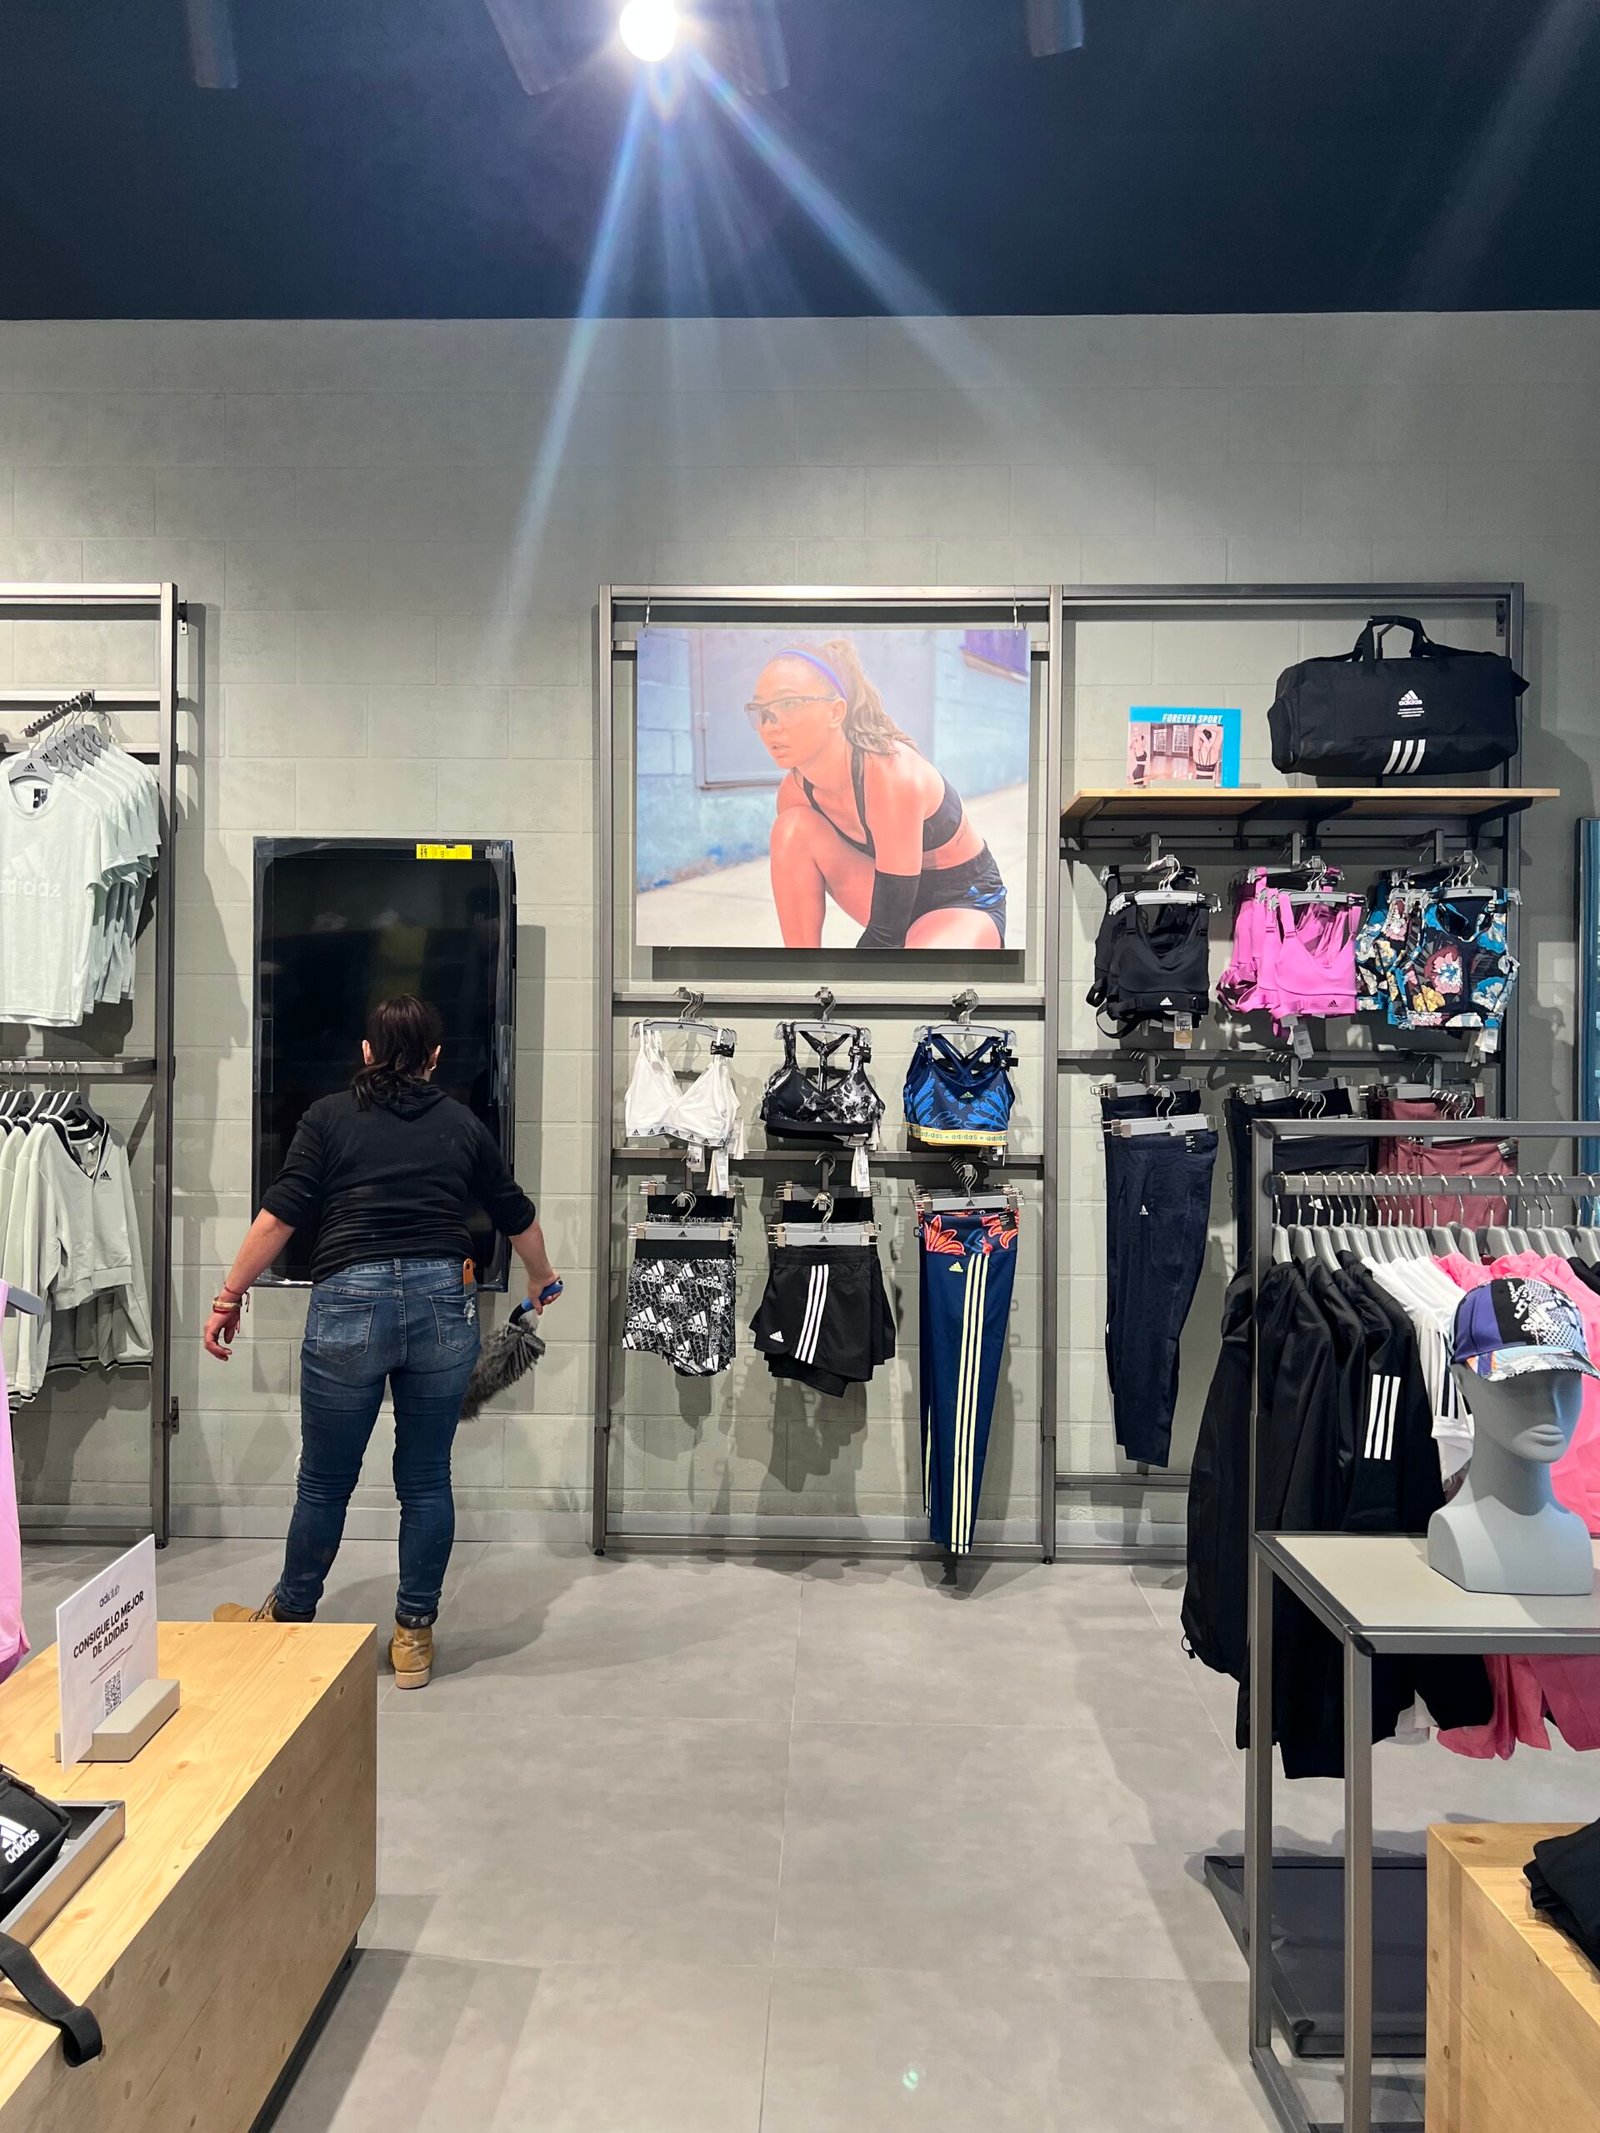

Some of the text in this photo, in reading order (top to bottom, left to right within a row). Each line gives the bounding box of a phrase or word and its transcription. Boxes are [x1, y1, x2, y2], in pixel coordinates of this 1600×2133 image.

[1161, 713, 1224, 725] FOREVER SPORT
[73, 1590, 144, 1659] CONSIGUE LO MEJOR
[92, 1618, 129, 1659] DE ADIDAS
[4, 1829, 40, 1864] adidas
